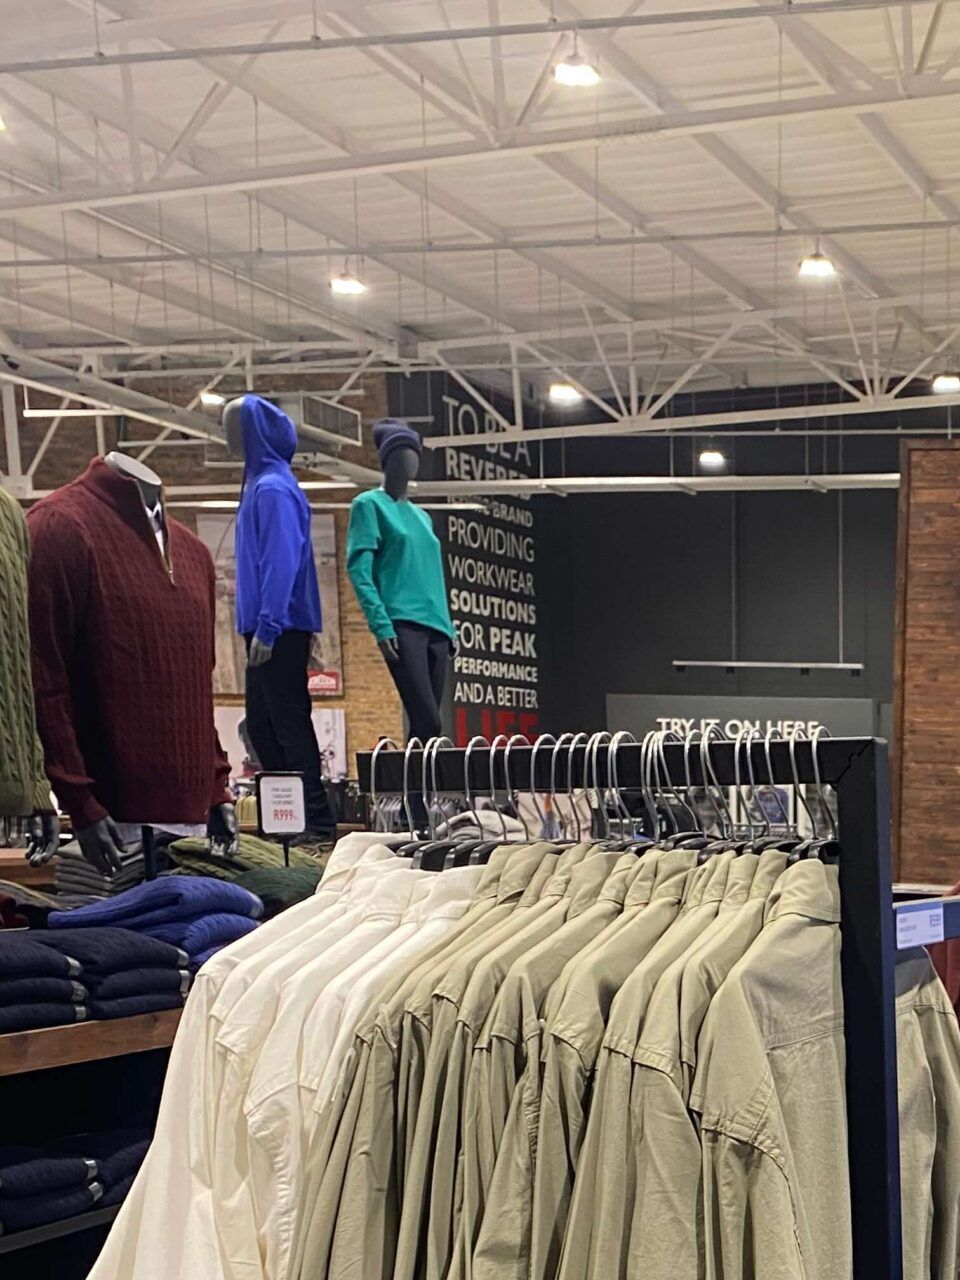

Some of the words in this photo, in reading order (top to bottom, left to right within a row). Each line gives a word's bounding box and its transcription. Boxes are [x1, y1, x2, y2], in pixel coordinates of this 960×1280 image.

[442, 394, 479, 437] TO
[493, 501, 534, 528] BRAND
[448, 515, 535, 562] PROVIDING
[448, 553, 536, 597] WORKWEAR
[450, 588, 537, 626] SOLUTIONS
[490, 626, 537, 659] PEAK
[454, 656, 538, 683] PERFORMANCE
[454, 681, 484, 704] AND
[485, 684, 496, 705] A
[497, 686, 539, 709] BETTER
[656, 718, 695, 738] TRY
[700, 718, 720, 738] IT
[725, 719, 760, 739] ON
